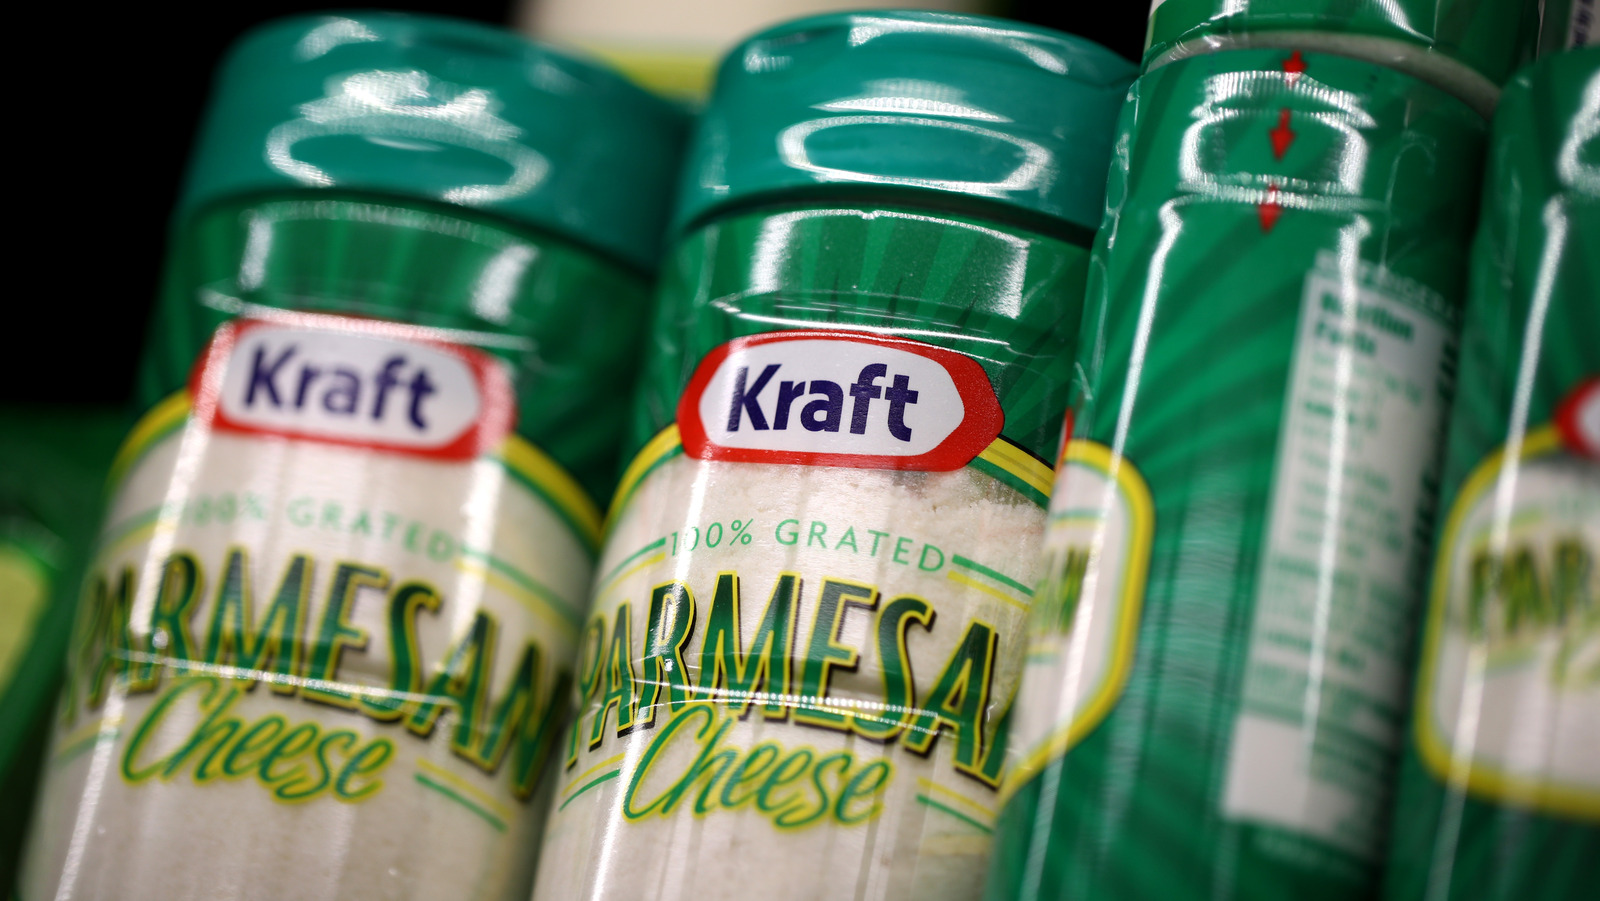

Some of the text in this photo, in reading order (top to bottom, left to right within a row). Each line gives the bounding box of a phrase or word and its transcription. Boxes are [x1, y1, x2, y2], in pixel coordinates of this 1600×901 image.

[242, 340, 440, 431] Kraft
[726, 362, 919, 442] Kraft
[286, 496, 456, 563] GRATED
[671, 518, 946, 572] 100% GRATED
[119, 676, 396, 801] Cheese
[624, 704, 896, 833] Cheese
